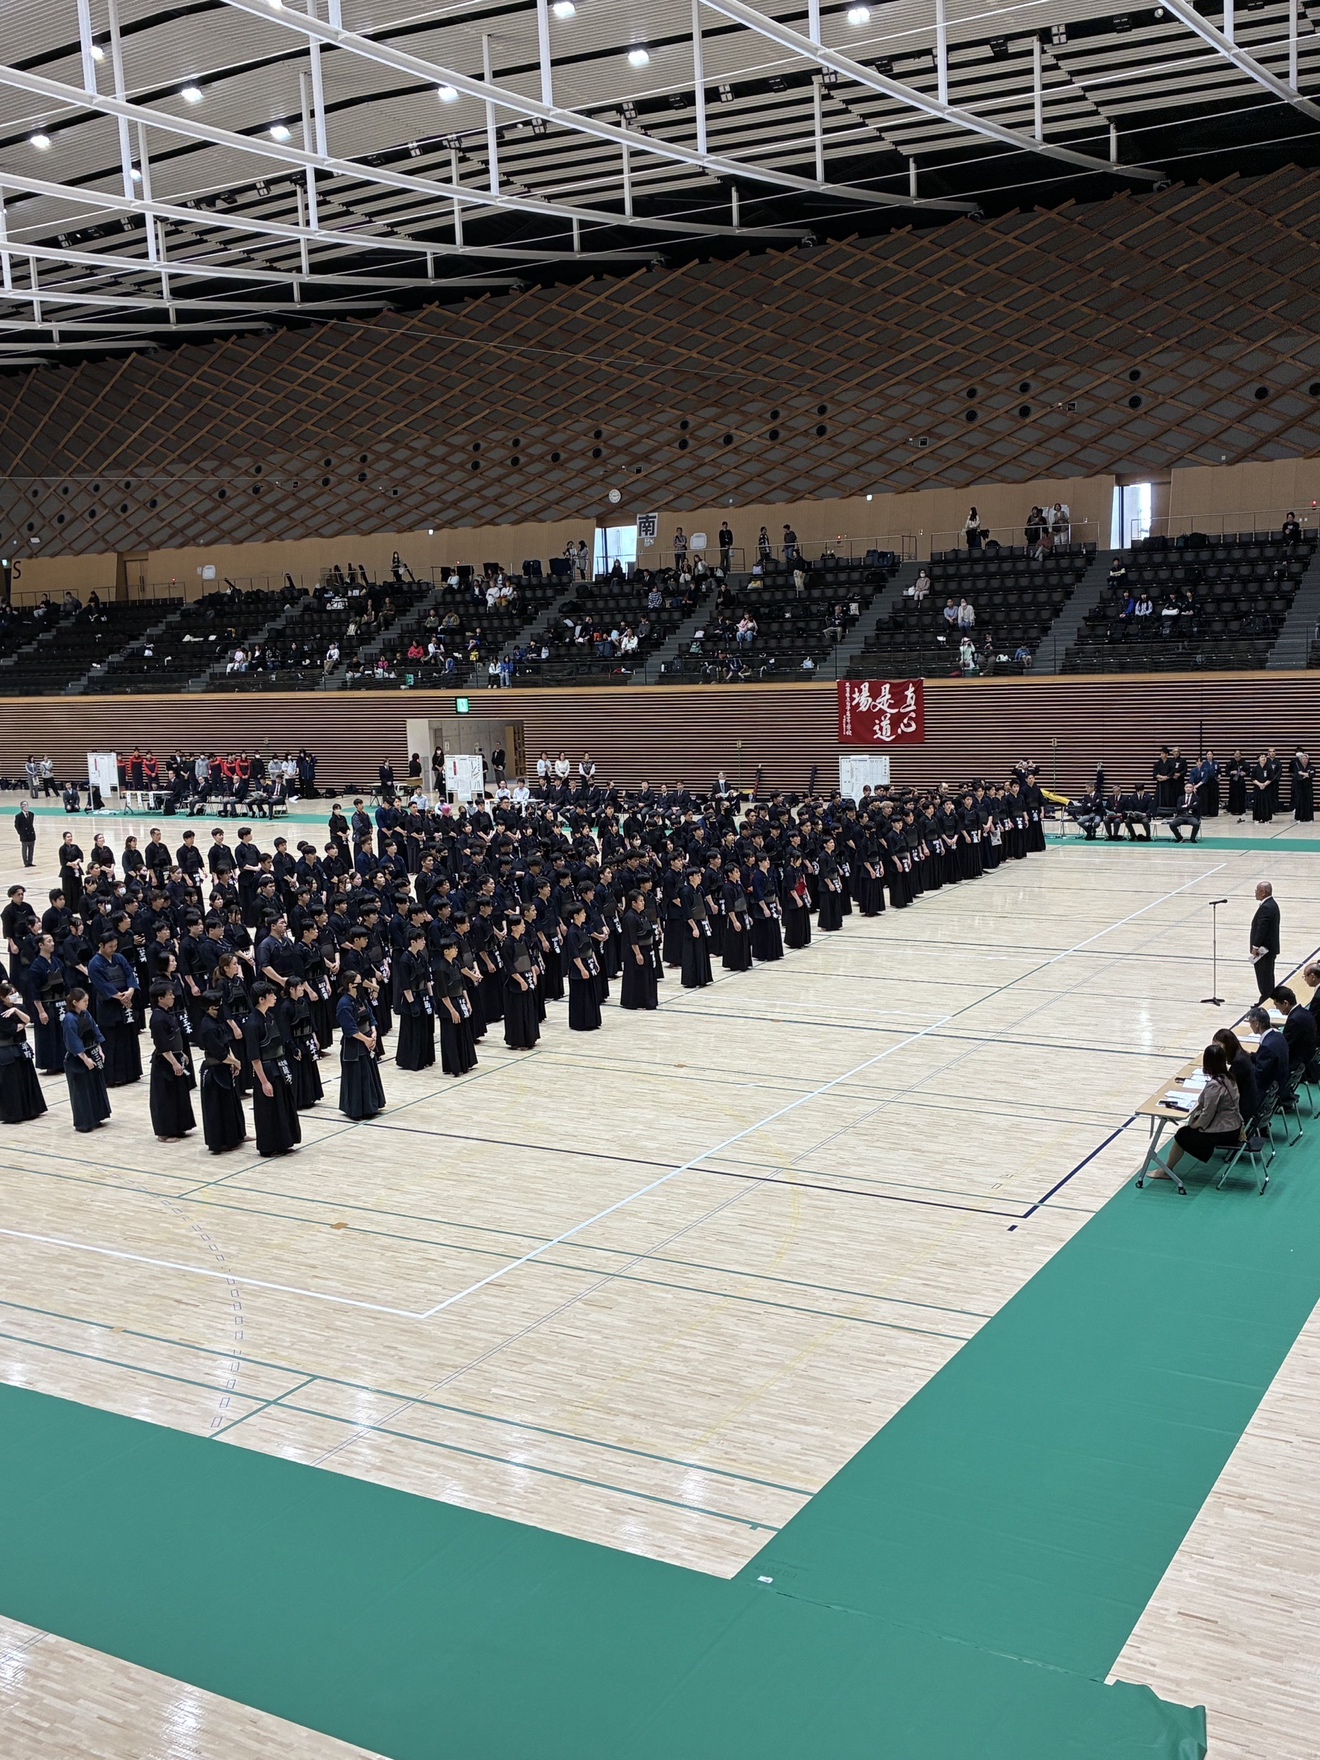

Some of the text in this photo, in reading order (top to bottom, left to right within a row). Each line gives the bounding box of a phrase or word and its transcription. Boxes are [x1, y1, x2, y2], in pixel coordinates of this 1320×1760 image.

[638, 514, 656, 537] 南
[13, 560, 21, 579] S
[852, 682, 872, 712] 場
